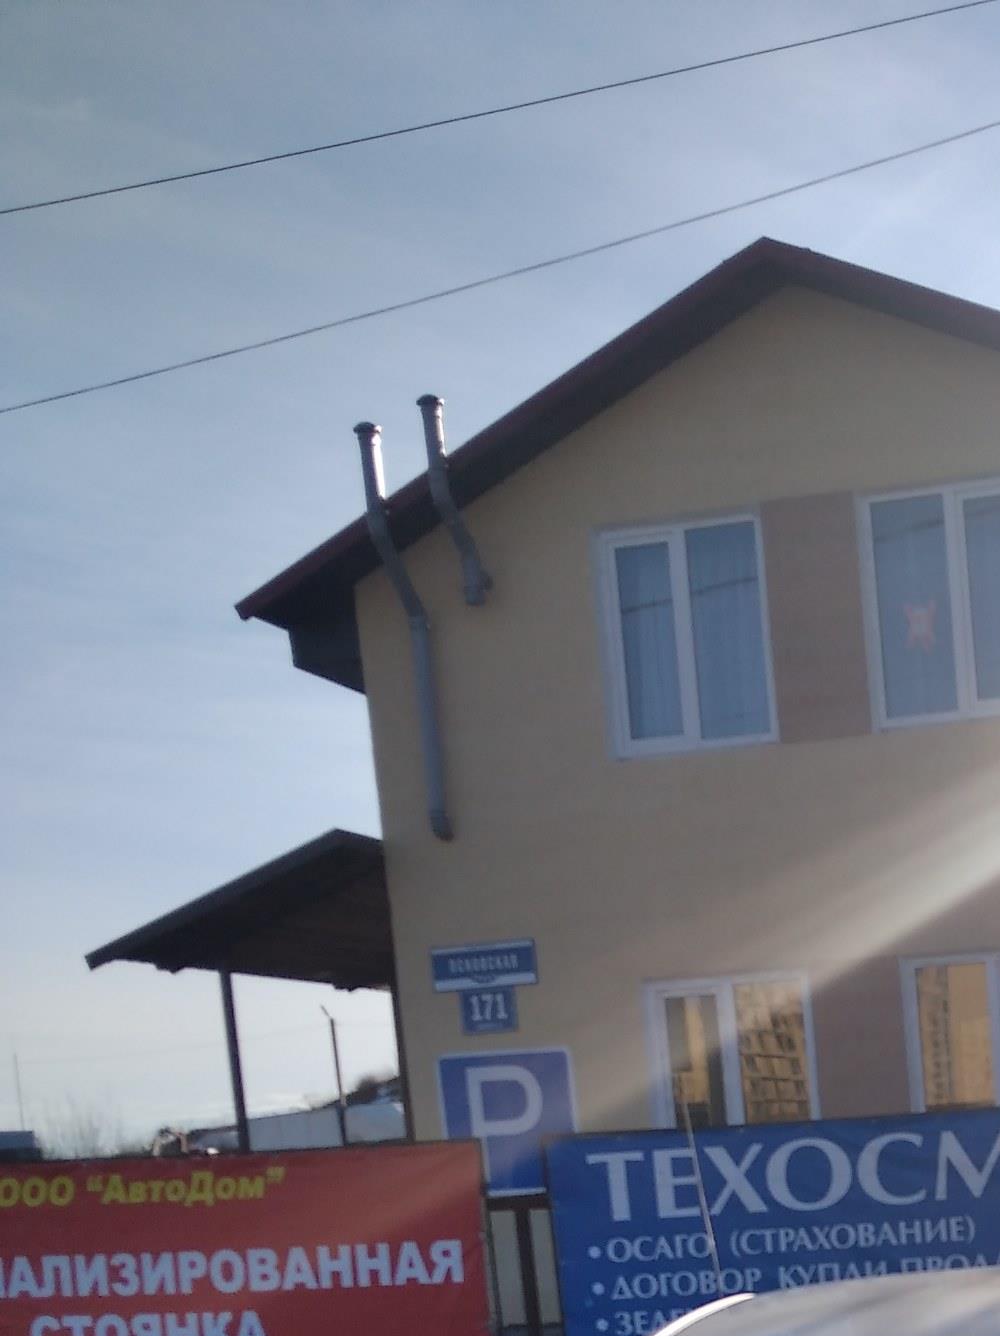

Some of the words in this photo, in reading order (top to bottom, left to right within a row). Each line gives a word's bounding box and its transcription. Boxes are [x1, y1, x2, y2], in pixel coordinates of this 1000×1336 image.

[469, 994, 508, 1021] 171
[606, 1232, 713, 1262] ОСАГО
[730, 1216, 976, 1257] (СТРАХОВАНИЕ)
[0, 1239, 464, 1299] АЛИЗИРОВАННАЯ
[611, 1270, 762, 1300] ДОГОВОР
